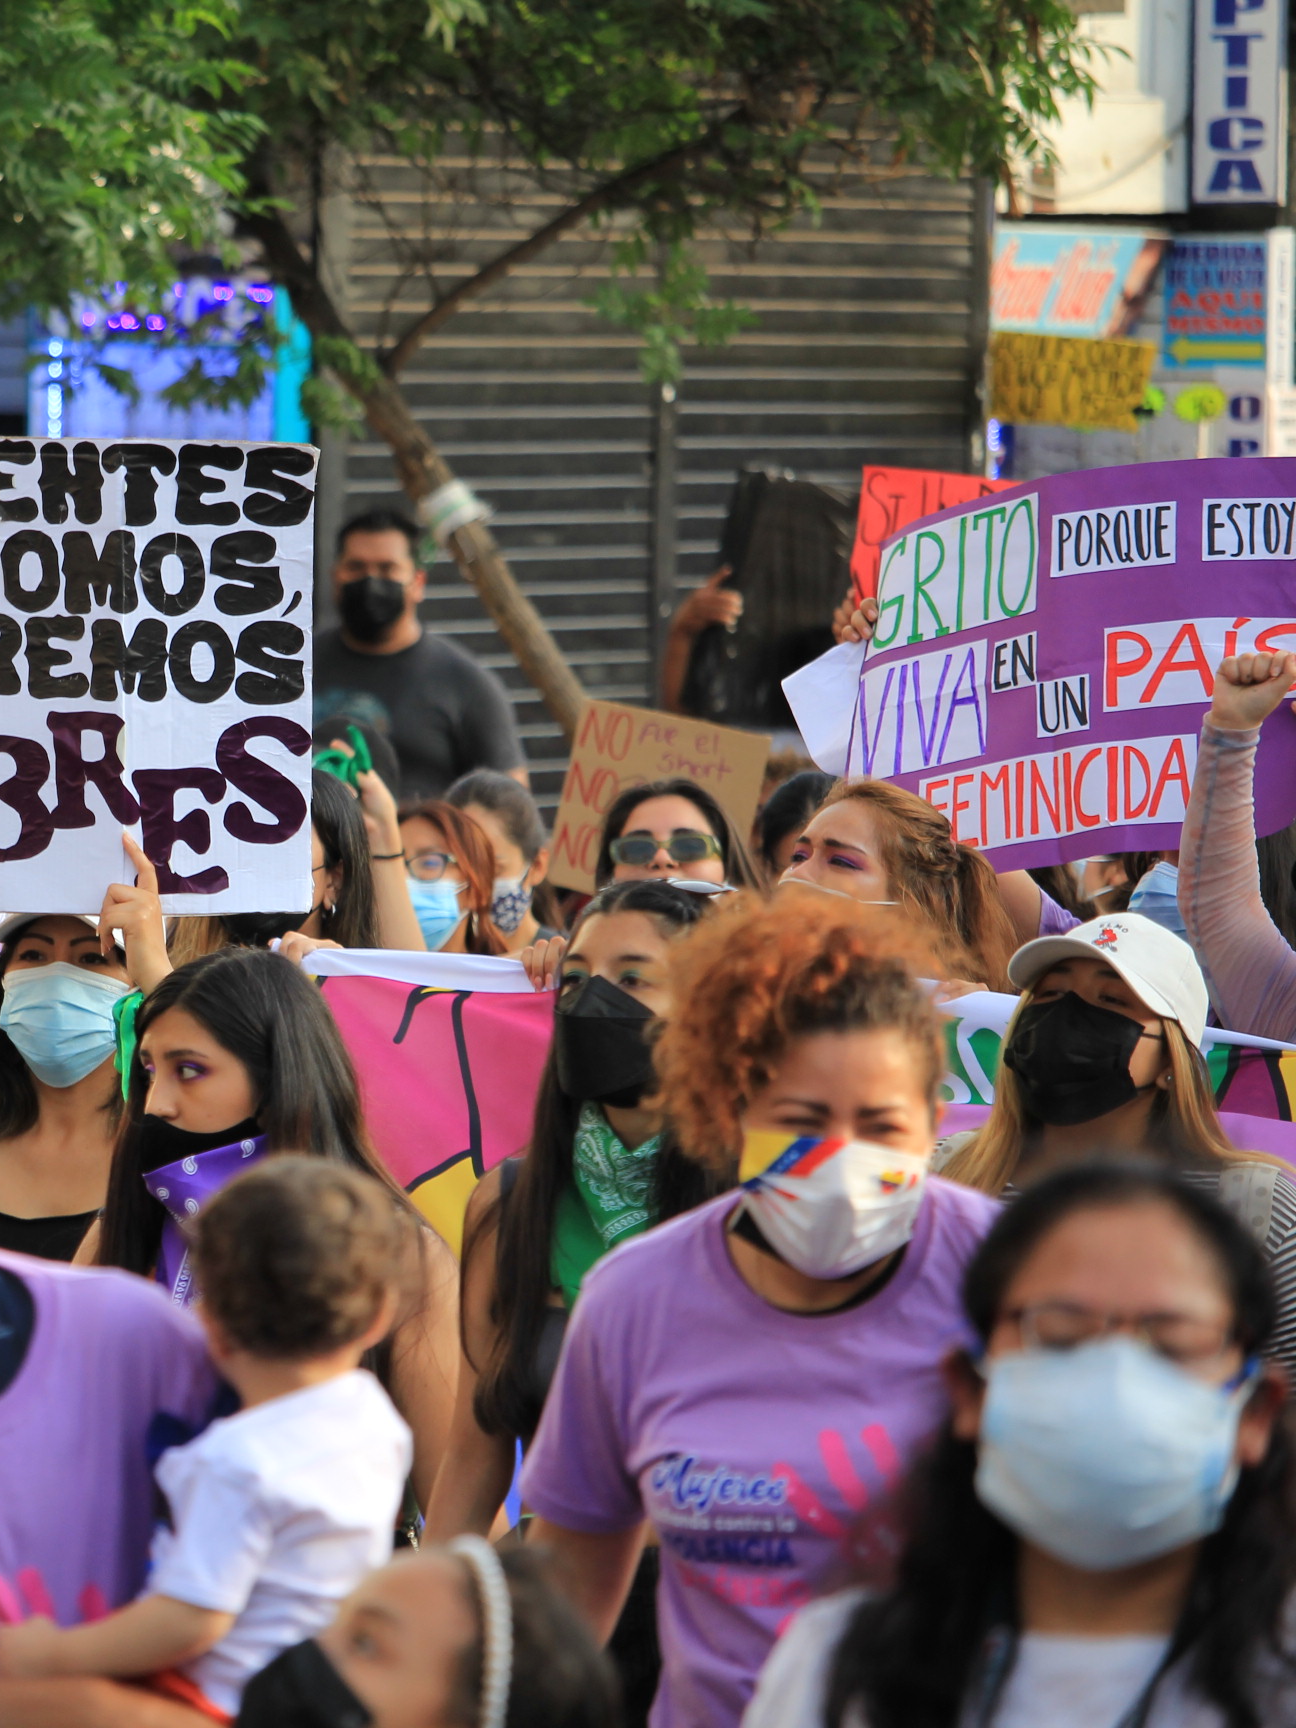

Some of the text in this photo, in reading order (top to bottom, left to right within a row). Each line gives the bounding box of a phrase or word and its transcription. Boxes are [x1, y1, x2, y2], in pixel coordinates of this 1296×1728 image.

[872, 497, 1035, 649] GRITO
[1058, 505, 1171, 572] PORQUE
[1207, 501, 1296, 557] ESTOY
[579, 708, 634, 761] NO
[860, 647, 986, 778] VIVA
[994, 634, 1035, 691] EN
[1040, 676, 1088, 734] UN
[564, 760, 621, 815] NO
[926, 738, 1192, 848] FEMINICIDA
[651, 1456, 787, 1510] Mujeres
